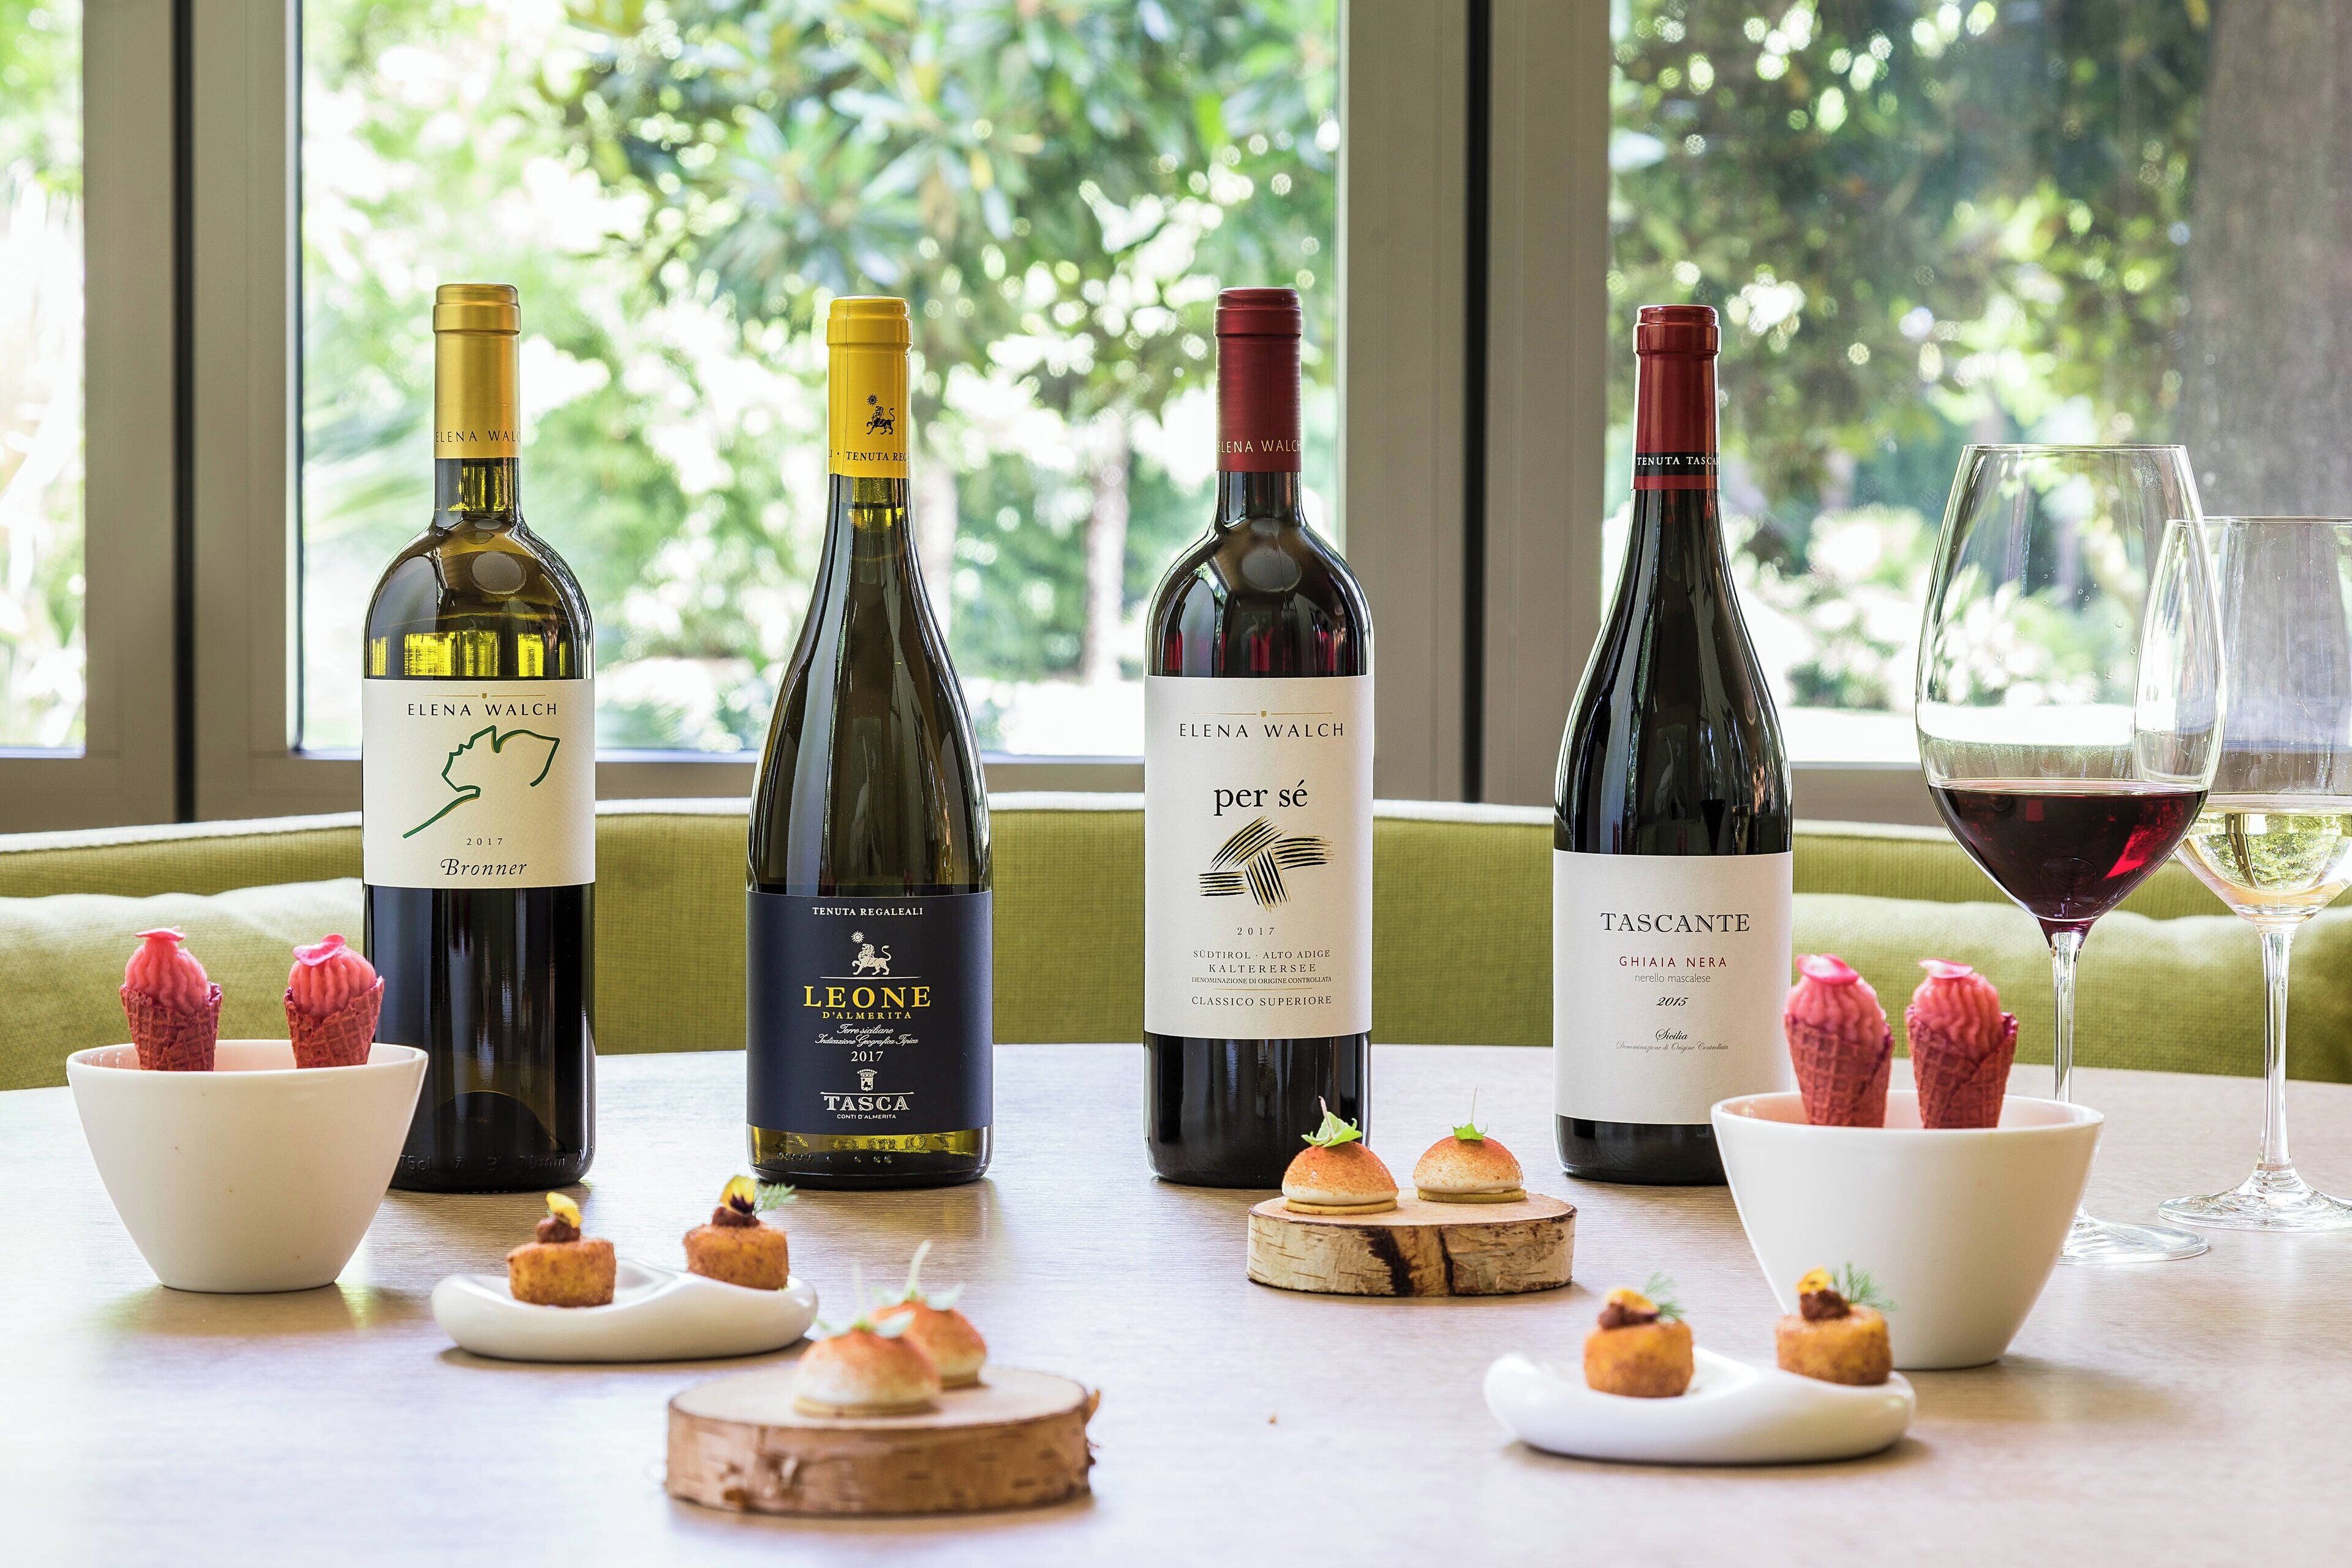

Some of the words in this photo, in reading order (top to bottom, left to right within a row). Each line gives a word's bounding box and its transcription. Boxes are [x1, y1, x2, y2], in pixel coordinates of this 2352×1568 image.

[435, 431, 477, 442] ELENA
[1217, 440, 1254, 453] ELENA
[1261, 439, 1302, 452] WALCH
[846, 451, 889, 461] TENUTA
[1637, 456, 1680, 466] TENUTA
[408, 703, 472, 716] ELENA
[485, 703, 557, 716] WALCH
[1180, 723, 1248, 738] ELENA
[1264, 722, 1344, 738] WALCH
[1213, 788, 1268, 816] per
[1279, 779, 1308, 808] sé
[440, 859, 527, 876] Bronner
[812, 907, 856, 916] TENUTA
[860, 907, 923, 916] REGALEALI
[1600, 913, 1751, 933] TASCANTE
[1237, 927, 1275, 936] 2017
[1193, 949, 1251, 960] SÜDTIROL
[1262, 951, 1292, 960] ALTO
[1297, 949, 1331, 959] ADIGE
[1619, 956, 1676, 968] GHIAIA
[1686, 957, 1727, 968] NERA
[1208, 963, 1317, 974] KALTERERSEE
[1287, 976, 1332, 984] CONTROLLATA
[1634, 973, 1665, 983] nerello
[1667, 973, 1711, 984] mascalese
[803, 986, 931, 1009] LEONE
[1192, 996, 1254, 1006] CLASSICO
[1259, 995, 1332, 1006] SUPERIORE
[1656, 997, 1689, 1007] 2015
[837, 1023, 860, 1034] Terre
[861, 1024, 894, 1035] siciliane
[1655, 1028, 1688, 1042] Sicilia
[815, 1034, 856, 1045] Indicazione
[855, 1034, 895, 1047] Geografica
[895, 1034, 919, 1046] Tipica
[1615, 1041, 1661, 1054] Denominazione
[1671, 1042, 1695, 1054] Origine
[1696, 1041, 1729, 1051] Controllata
[850, 1050, 884, 1062] 2017
[823, 1095, 910, 1111] TASCA
